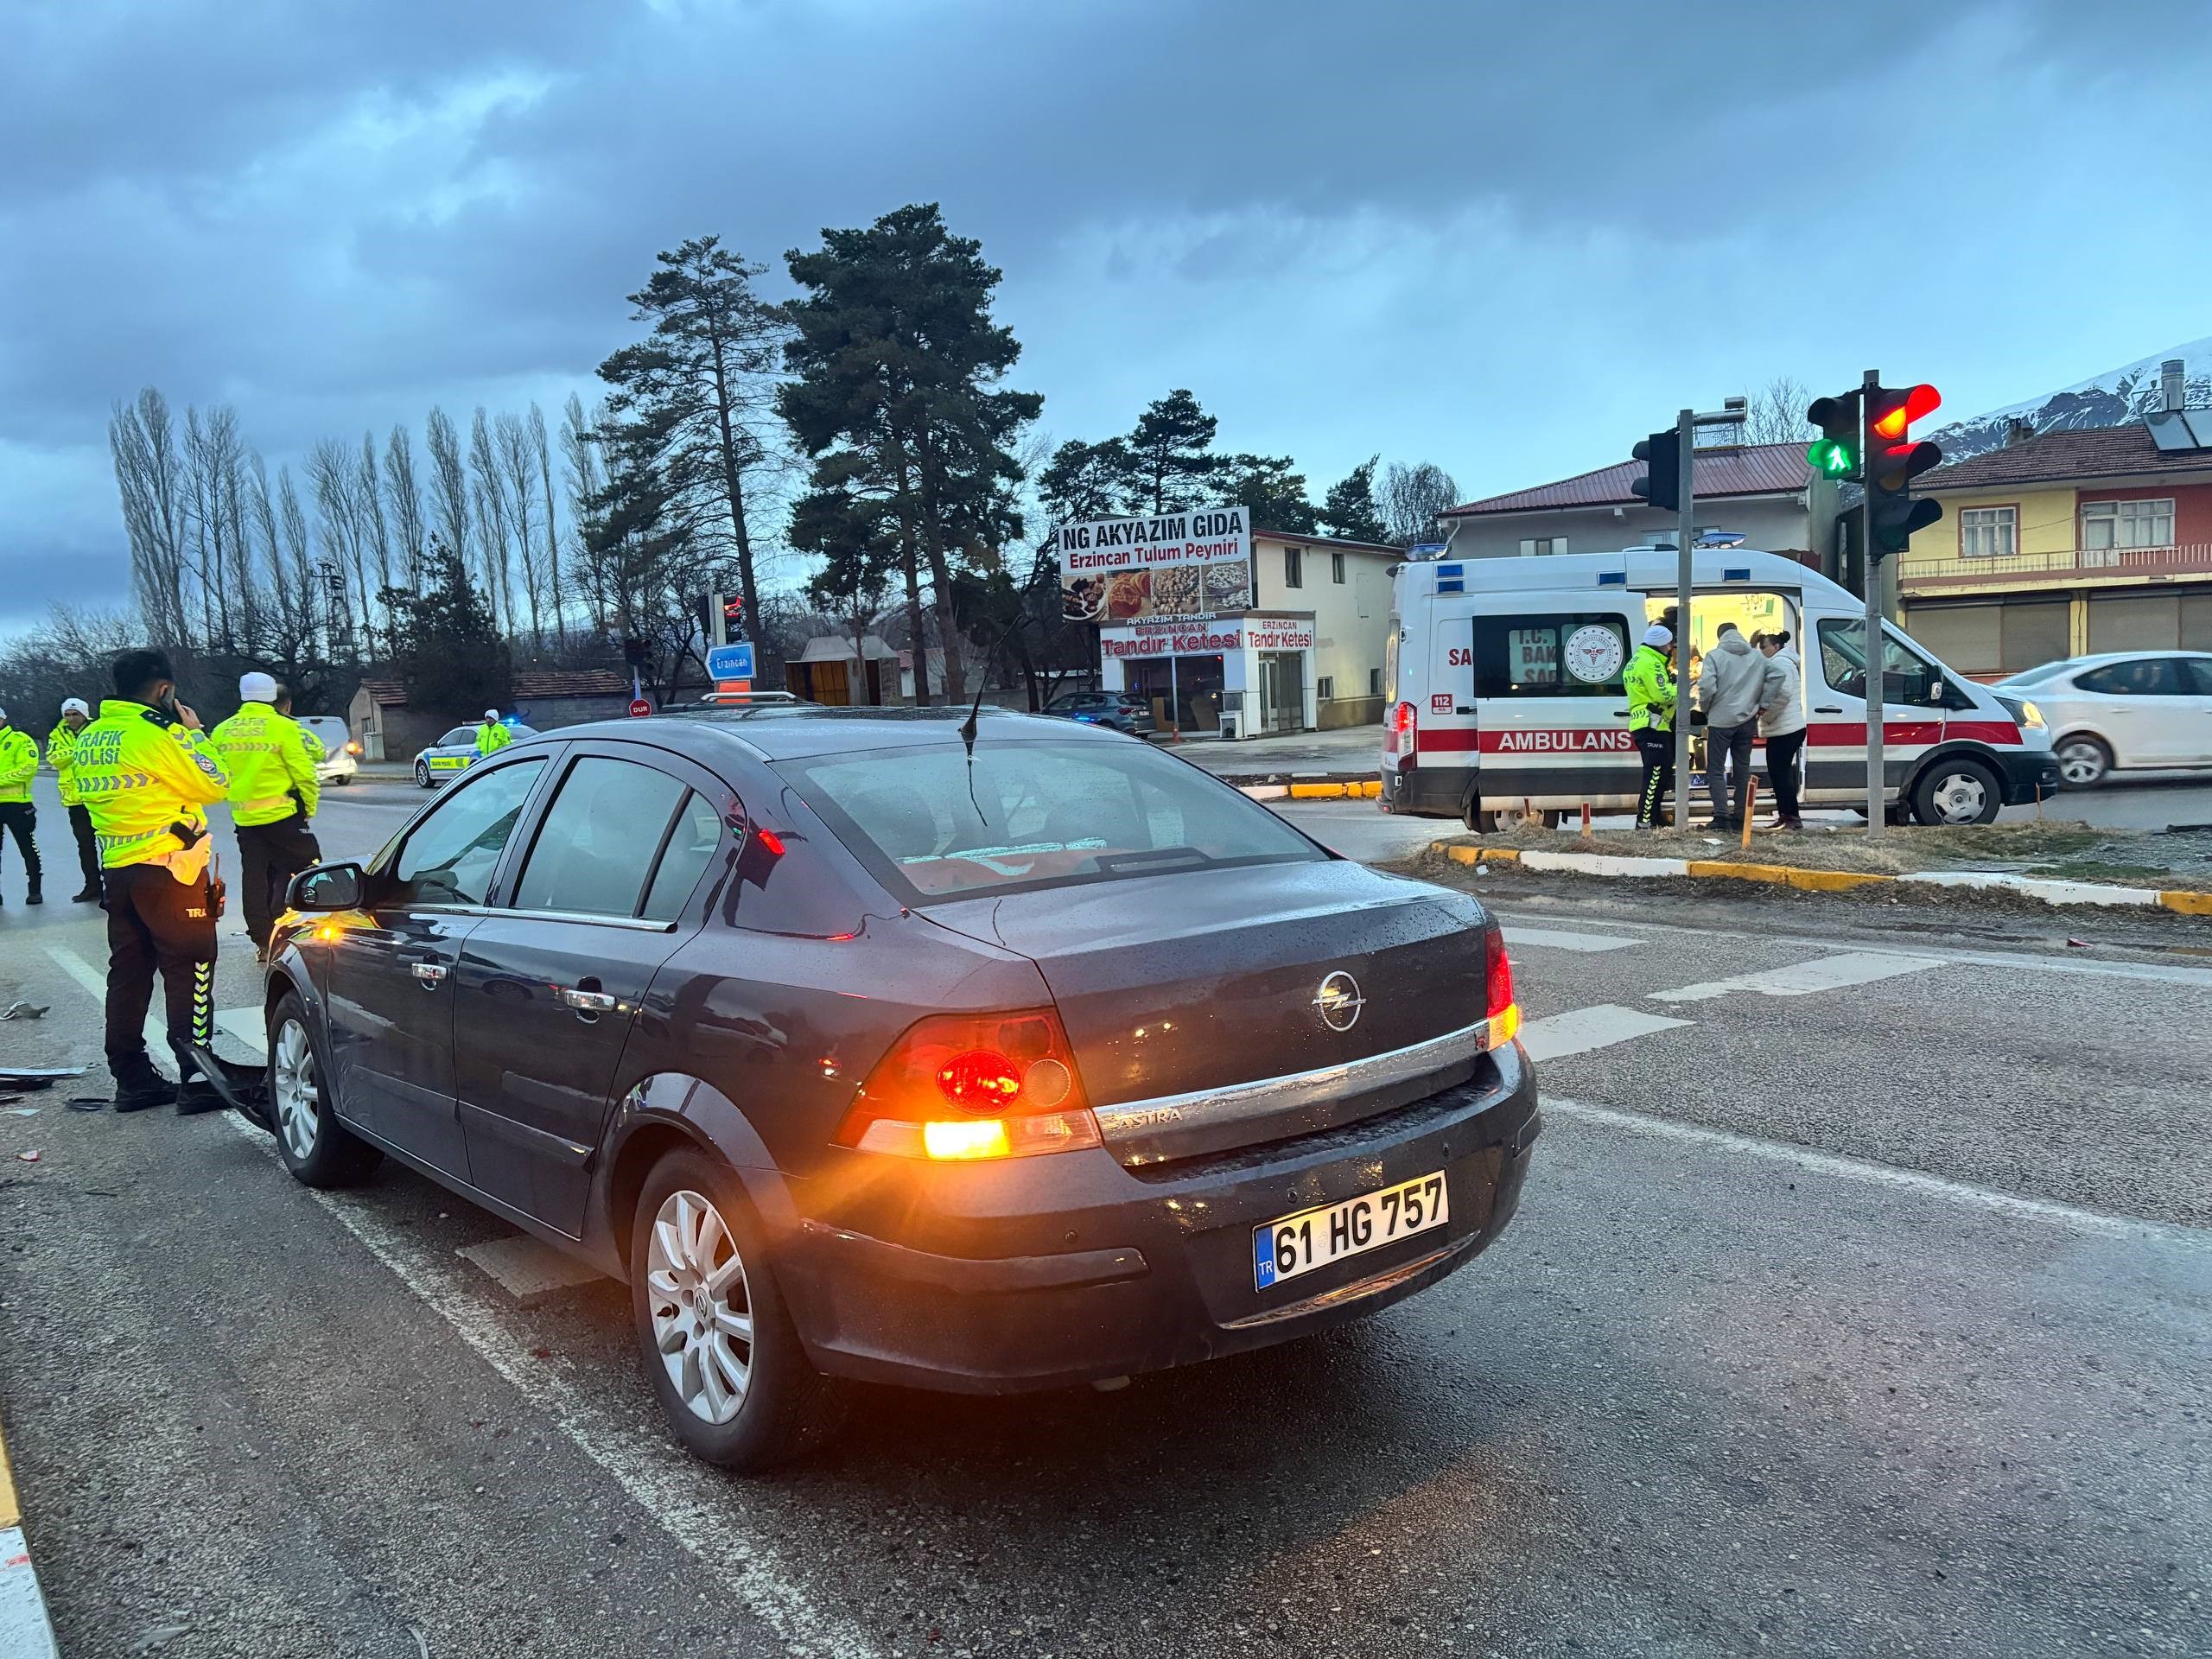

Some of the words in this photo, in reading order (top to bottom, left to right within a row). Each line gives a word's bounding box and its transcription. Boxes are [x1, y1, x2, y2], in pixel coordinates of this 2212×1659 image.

[1064, 527, 1090, 550] NG
[1095, 518, 1186, 548] AKYAZIM
[1192, 512, 1243, 538] GIDA
[1070, 551, 1130, 569] Erzincan
[1135, 545, 1181, 563] Tulum
[1185, 537, 1238, 560] Peyniri
[1127, 615, 1173, 626] AKYAZIM
[1173, 629, 1243, 652] Ketesi
[1281, 630, 1312, 648] Ketesi
[716, 657, 747, 670] Erzincan
[1434, 696, 1450, 707] 112
[1498, 732, 1632, 751] AMBULANS
[1116, 1107, 1183, 1131] ASTRA
[1275, 1219, 1313, 1274] 61
[1330, 1201, 1372, 1255] HG
[1381, 1176, 1442, 1236] 757
[1258, 1260, 1273, 1276] TR
